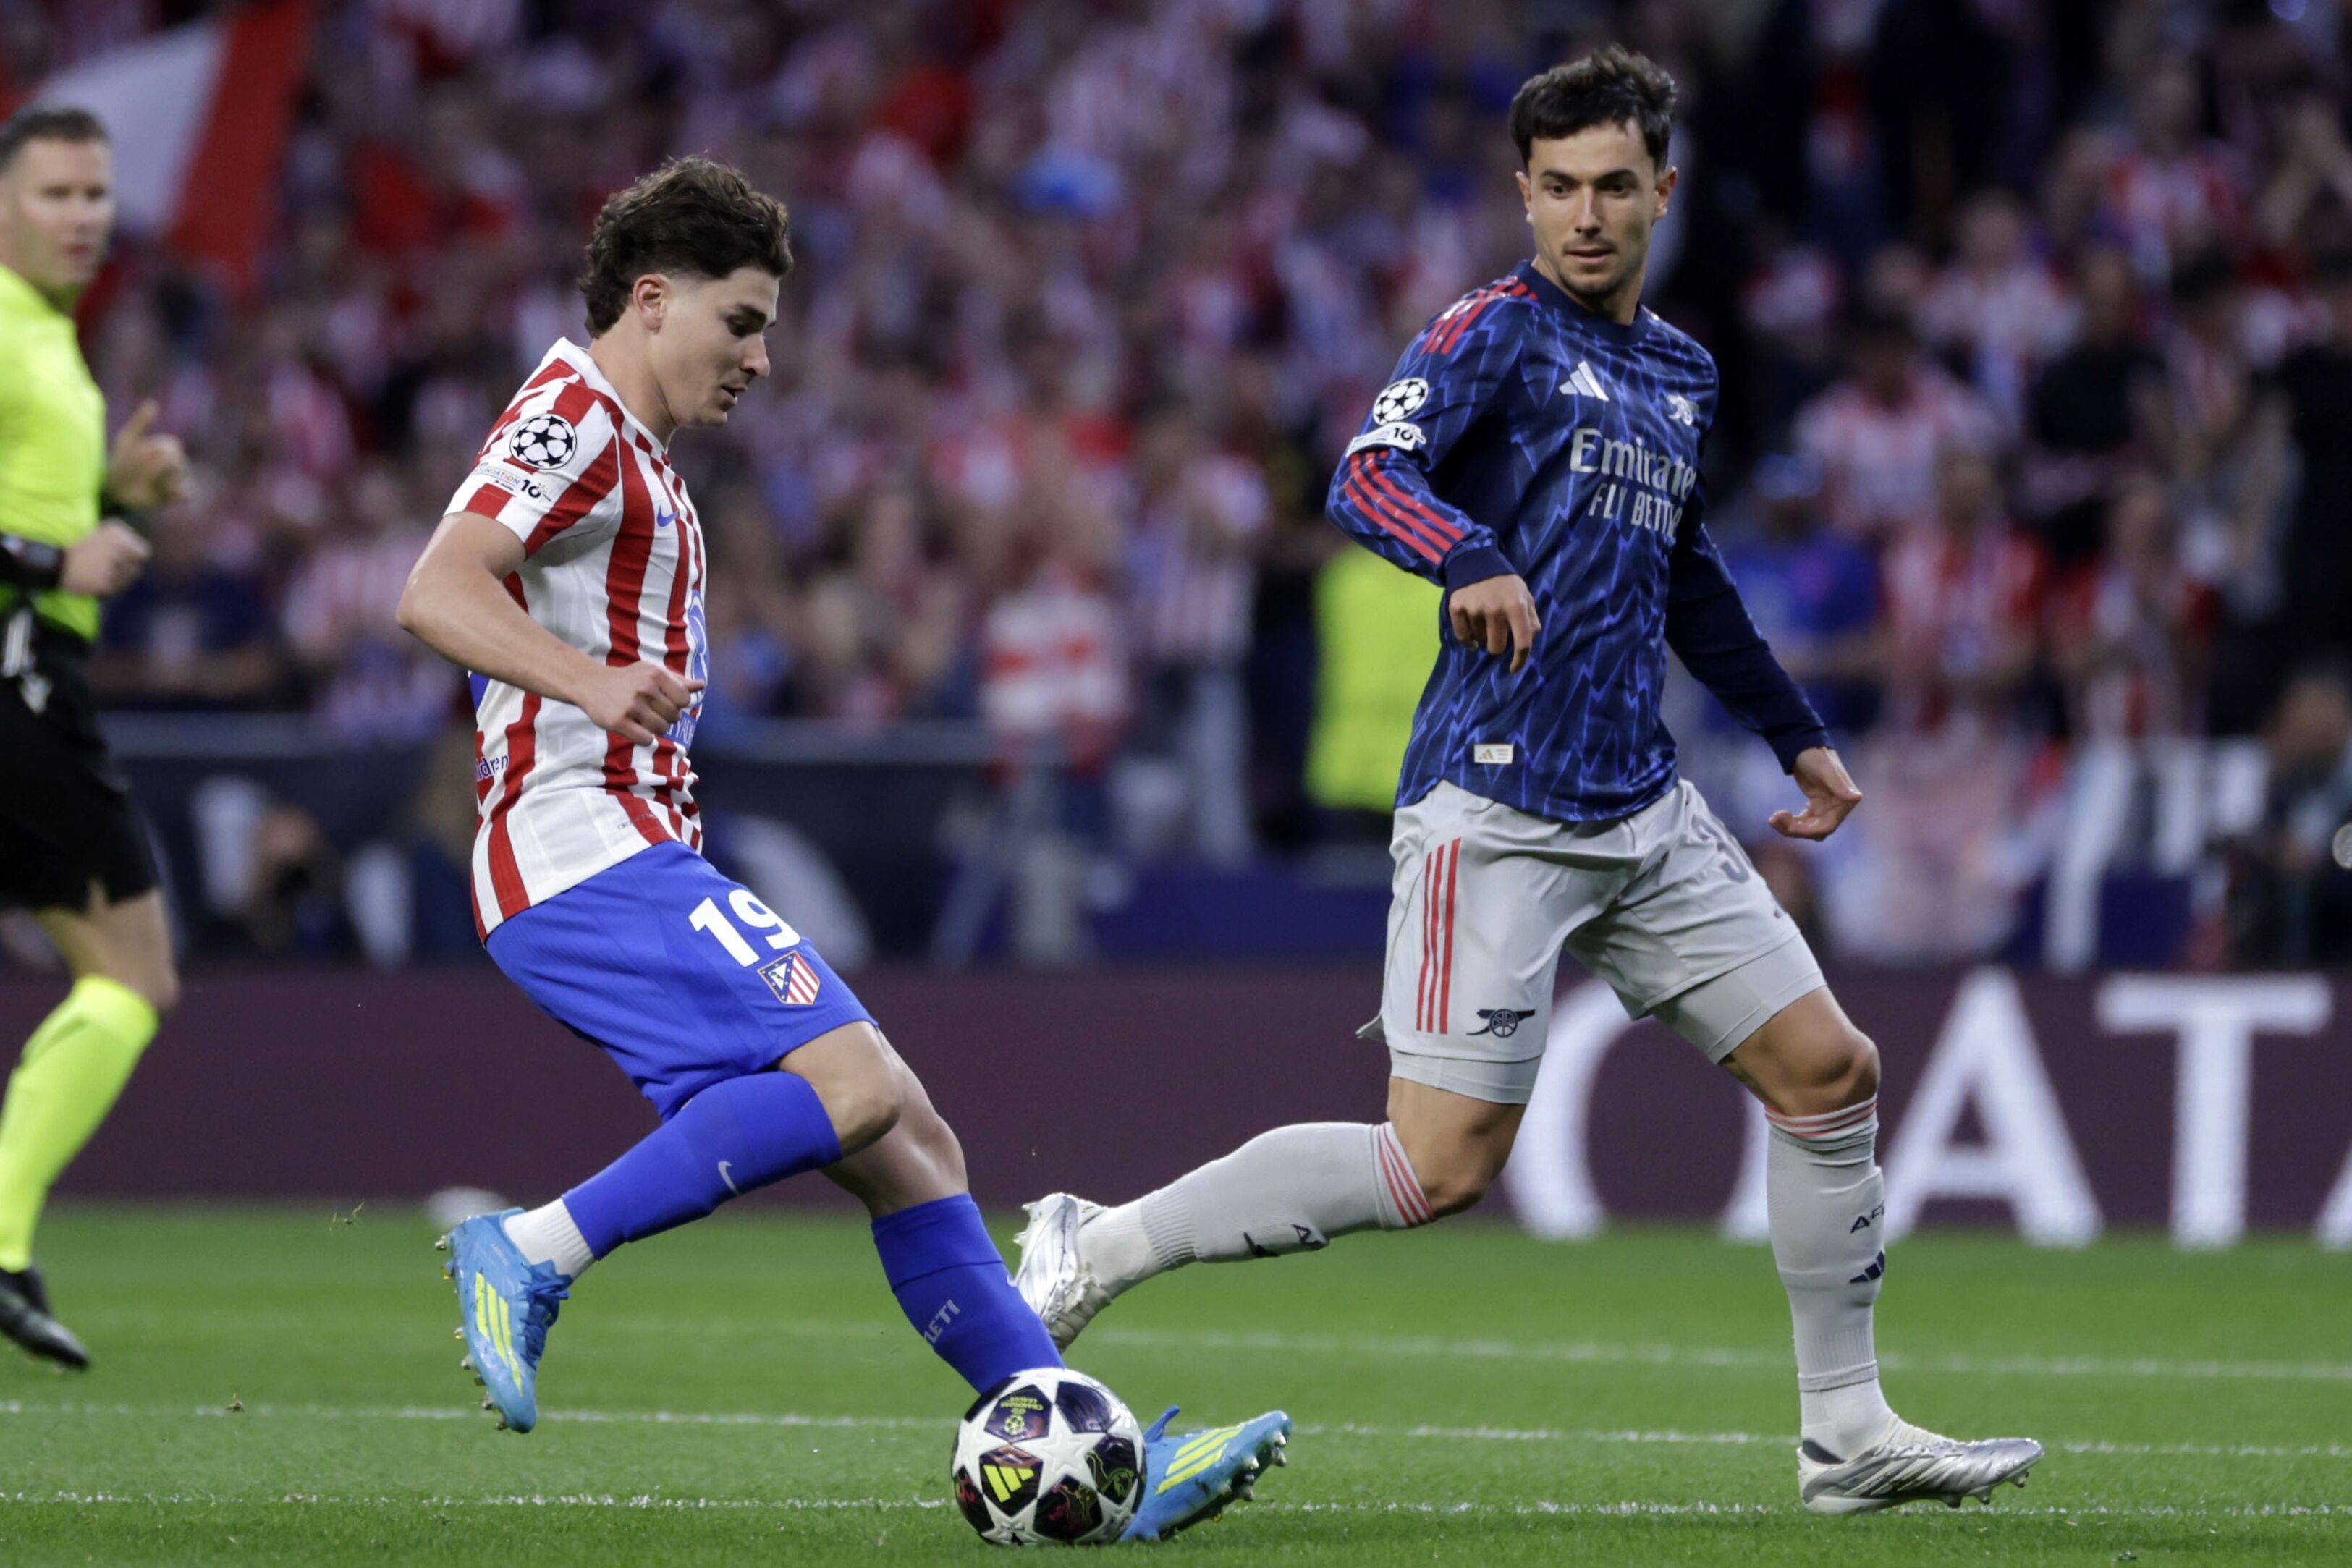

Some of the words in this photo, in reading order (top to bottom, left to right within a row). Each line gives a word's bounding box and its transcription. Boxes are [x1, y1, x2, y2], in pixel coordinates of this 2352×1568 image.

[1570, 428, 1697, 501] Emirate
[1588, 483, 1628, 520] FLY
[688, 889, 800, 967] 19
[1850, 1200, 1885, 1234] AF
[924, 1298, 961, 1344] LETI
